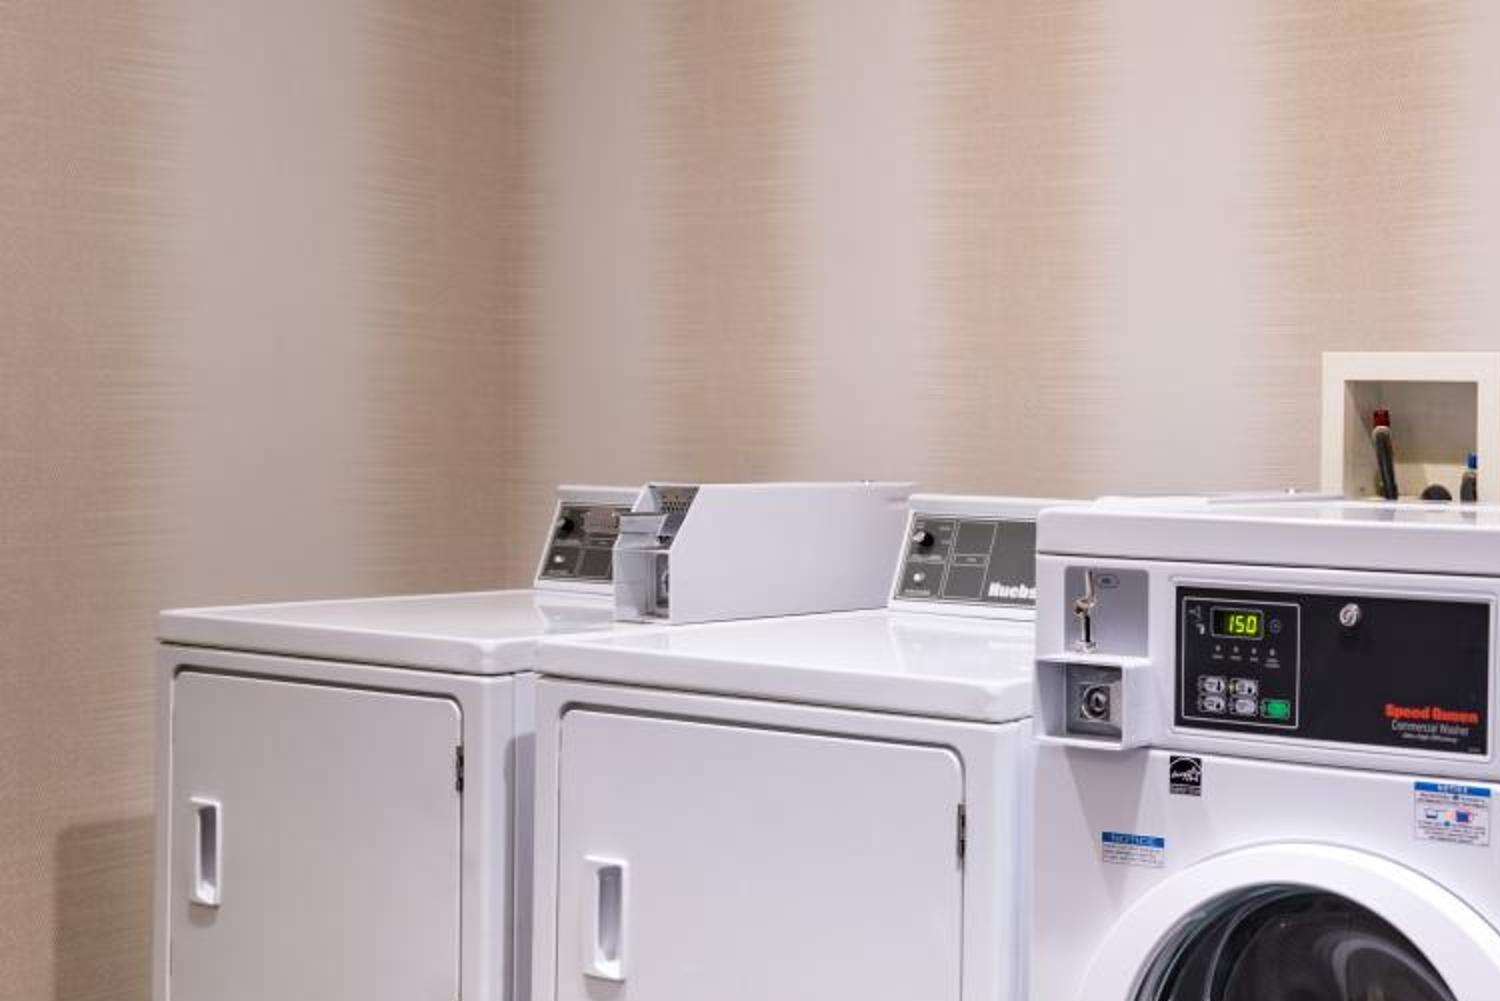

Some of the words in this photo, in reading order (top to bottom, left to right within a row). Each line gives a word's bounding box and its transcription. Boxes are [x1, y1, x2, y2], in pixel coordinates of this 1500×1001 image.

[988, 581, 1038, 599] Huebs
[1228, 615, 1258, 633] 150
[1385, 703, 1431, 719] Speed
[1432, 706, 1479, 724] Queen
